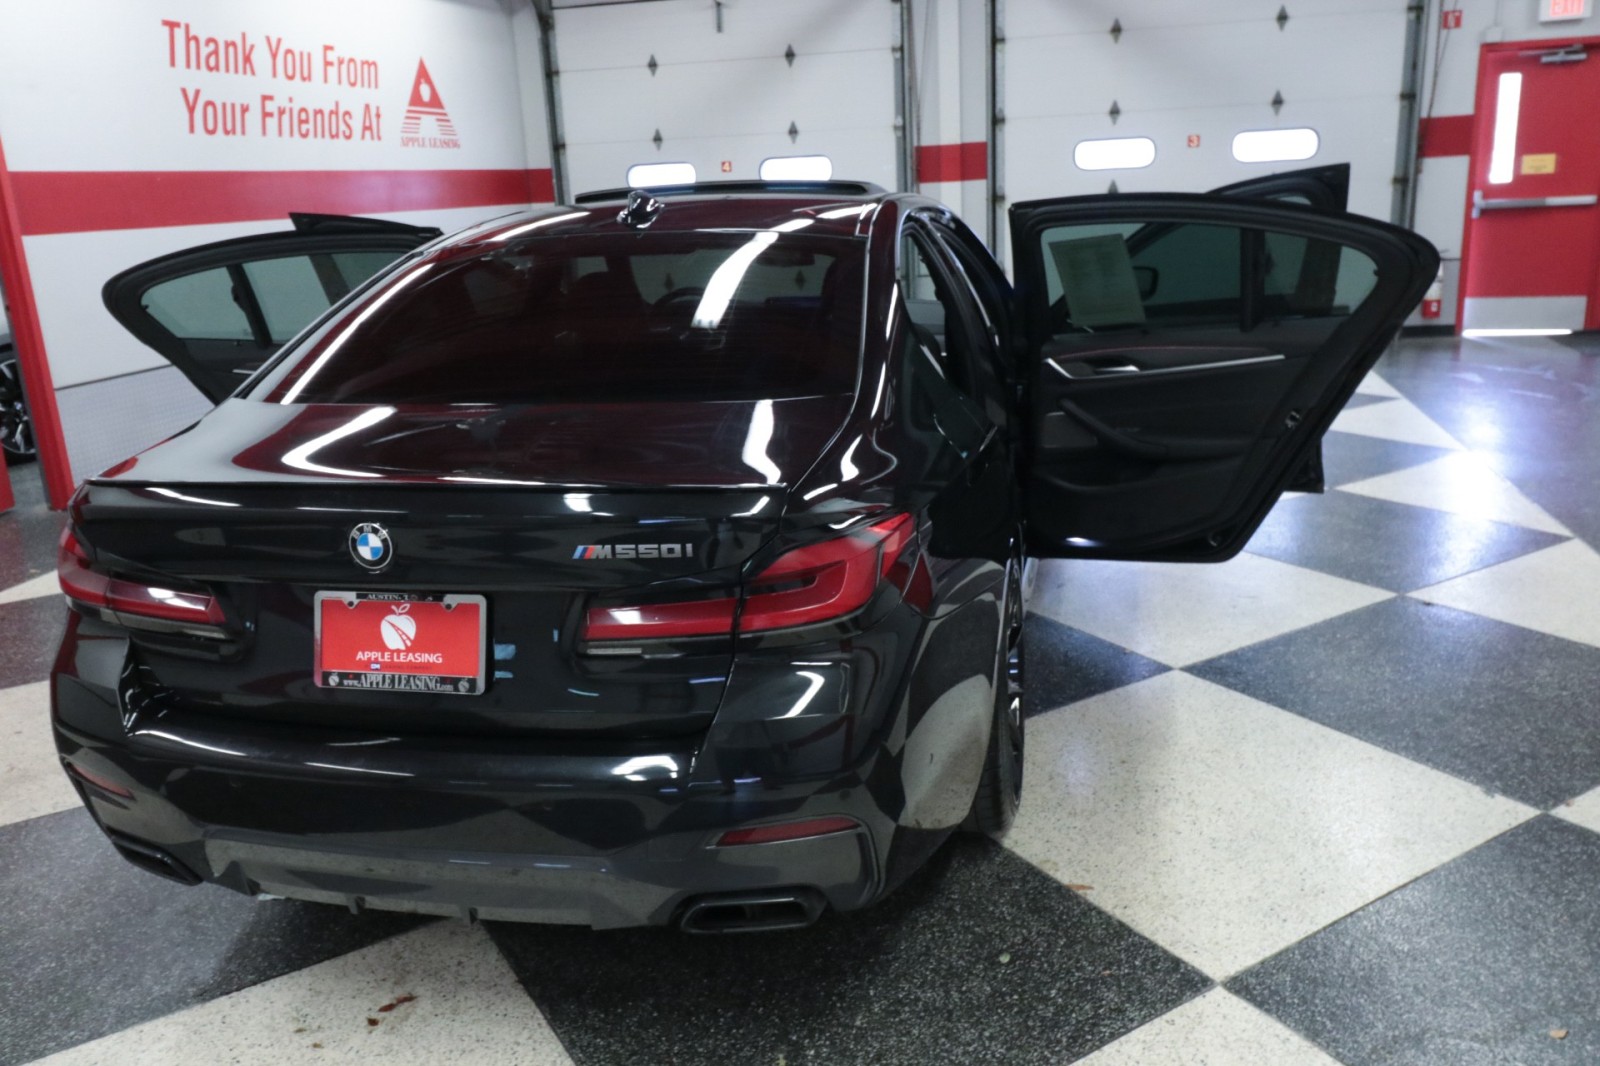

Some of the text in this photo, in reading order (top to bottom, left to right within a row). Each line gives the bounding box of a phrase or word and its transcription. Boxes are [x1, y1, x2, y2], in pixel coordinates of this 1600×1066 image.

[161, 19, 379, 90] Thank You From
[180, 87, 382, 141] Your Friends At
[400, 136, 428, 148] APPLE
[351, 525, 387, 540] BMW
[356, 651, 443, 664] APPLE LEASING
